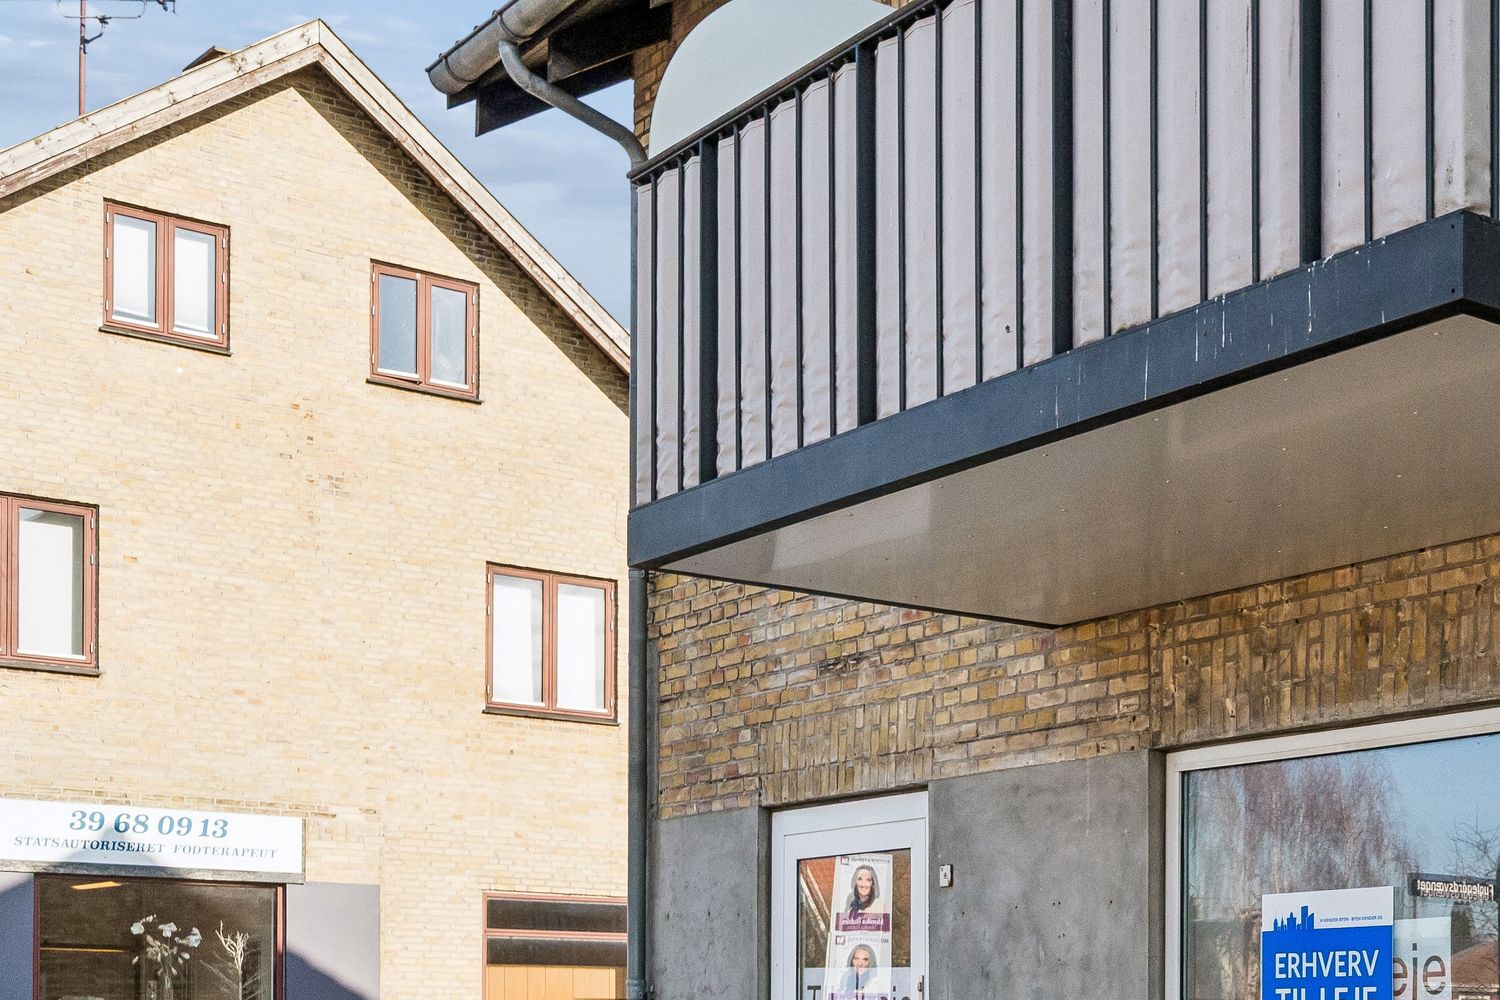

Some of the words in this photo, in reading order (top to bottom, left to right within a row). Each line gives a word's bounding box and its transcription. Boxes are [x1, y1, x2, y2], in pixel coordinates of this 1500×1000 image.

[69, 810, 106, 831] 39
[113, 813, 149, 834] 68
[158, 815, 193, 836] 09
[199, 818, 229, 838] 13
[13, 835, 166, 853] STATSAUTORISERET
[1275, 949, 1379, 979] ERHVERV
